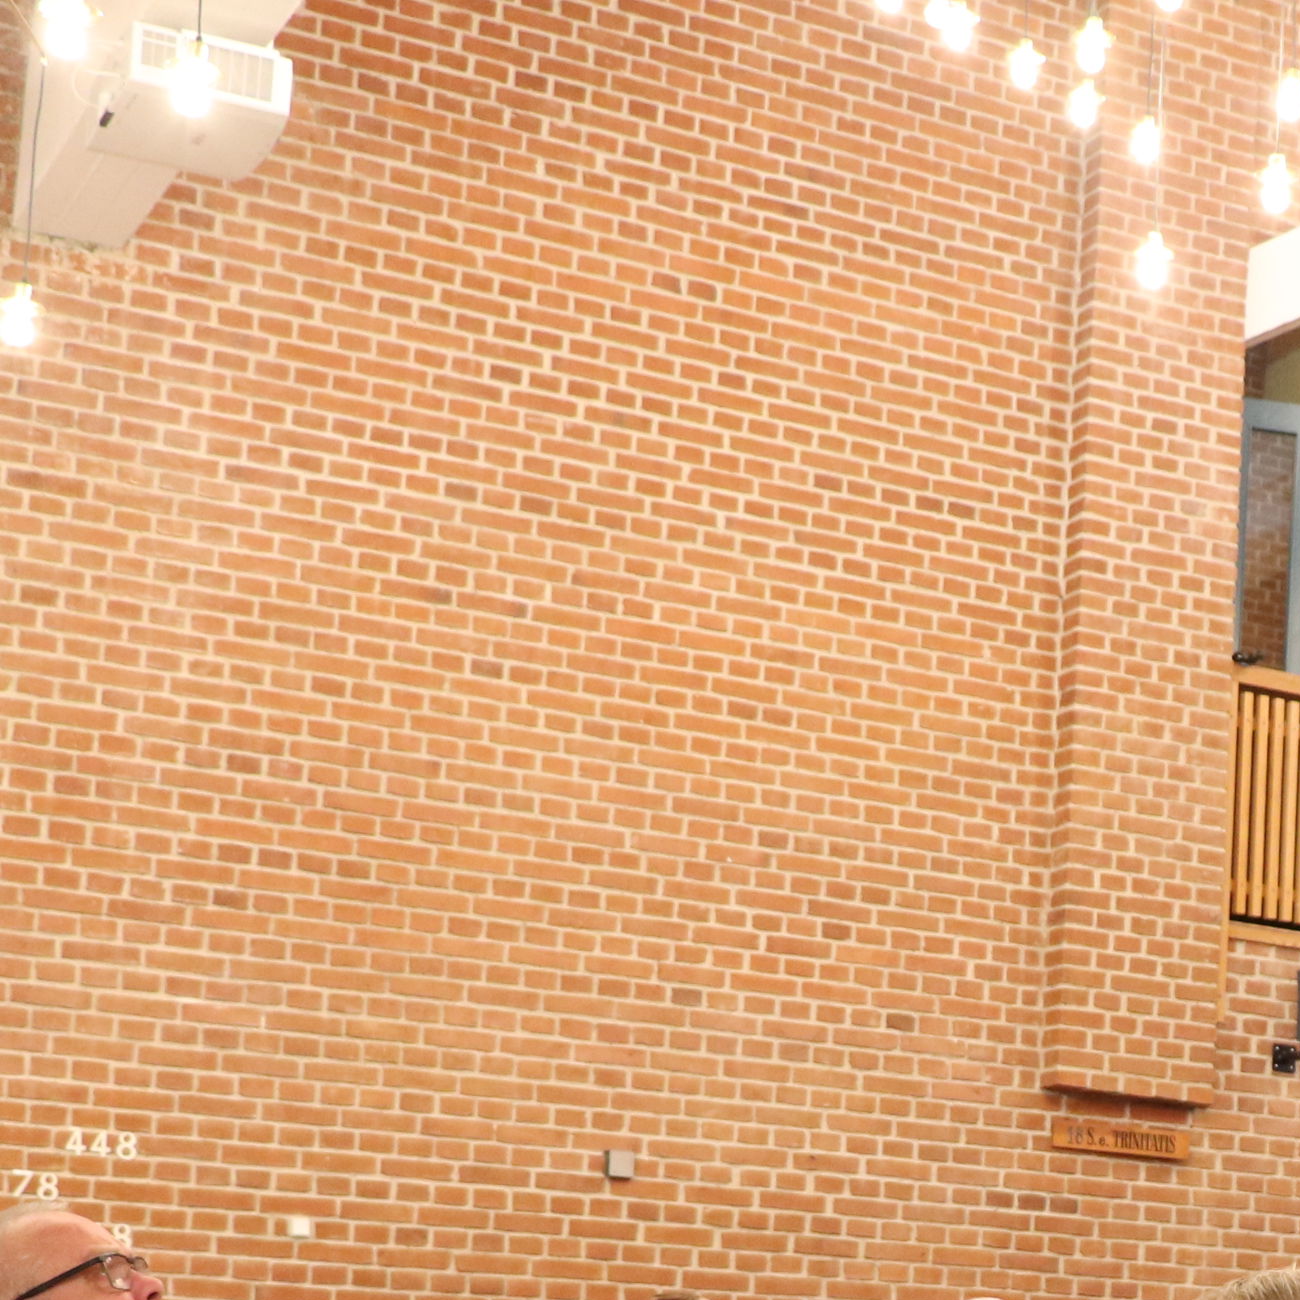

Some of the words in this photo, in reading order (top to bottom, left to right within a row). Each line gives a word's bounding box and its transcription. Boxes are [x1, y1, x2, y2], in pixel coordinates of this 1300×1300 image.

[65, 1126, 138, 1161] 448
[1112, 1129, 1177, 1154] TRINITATIS
[11, 1168, 59, 1201] 78
